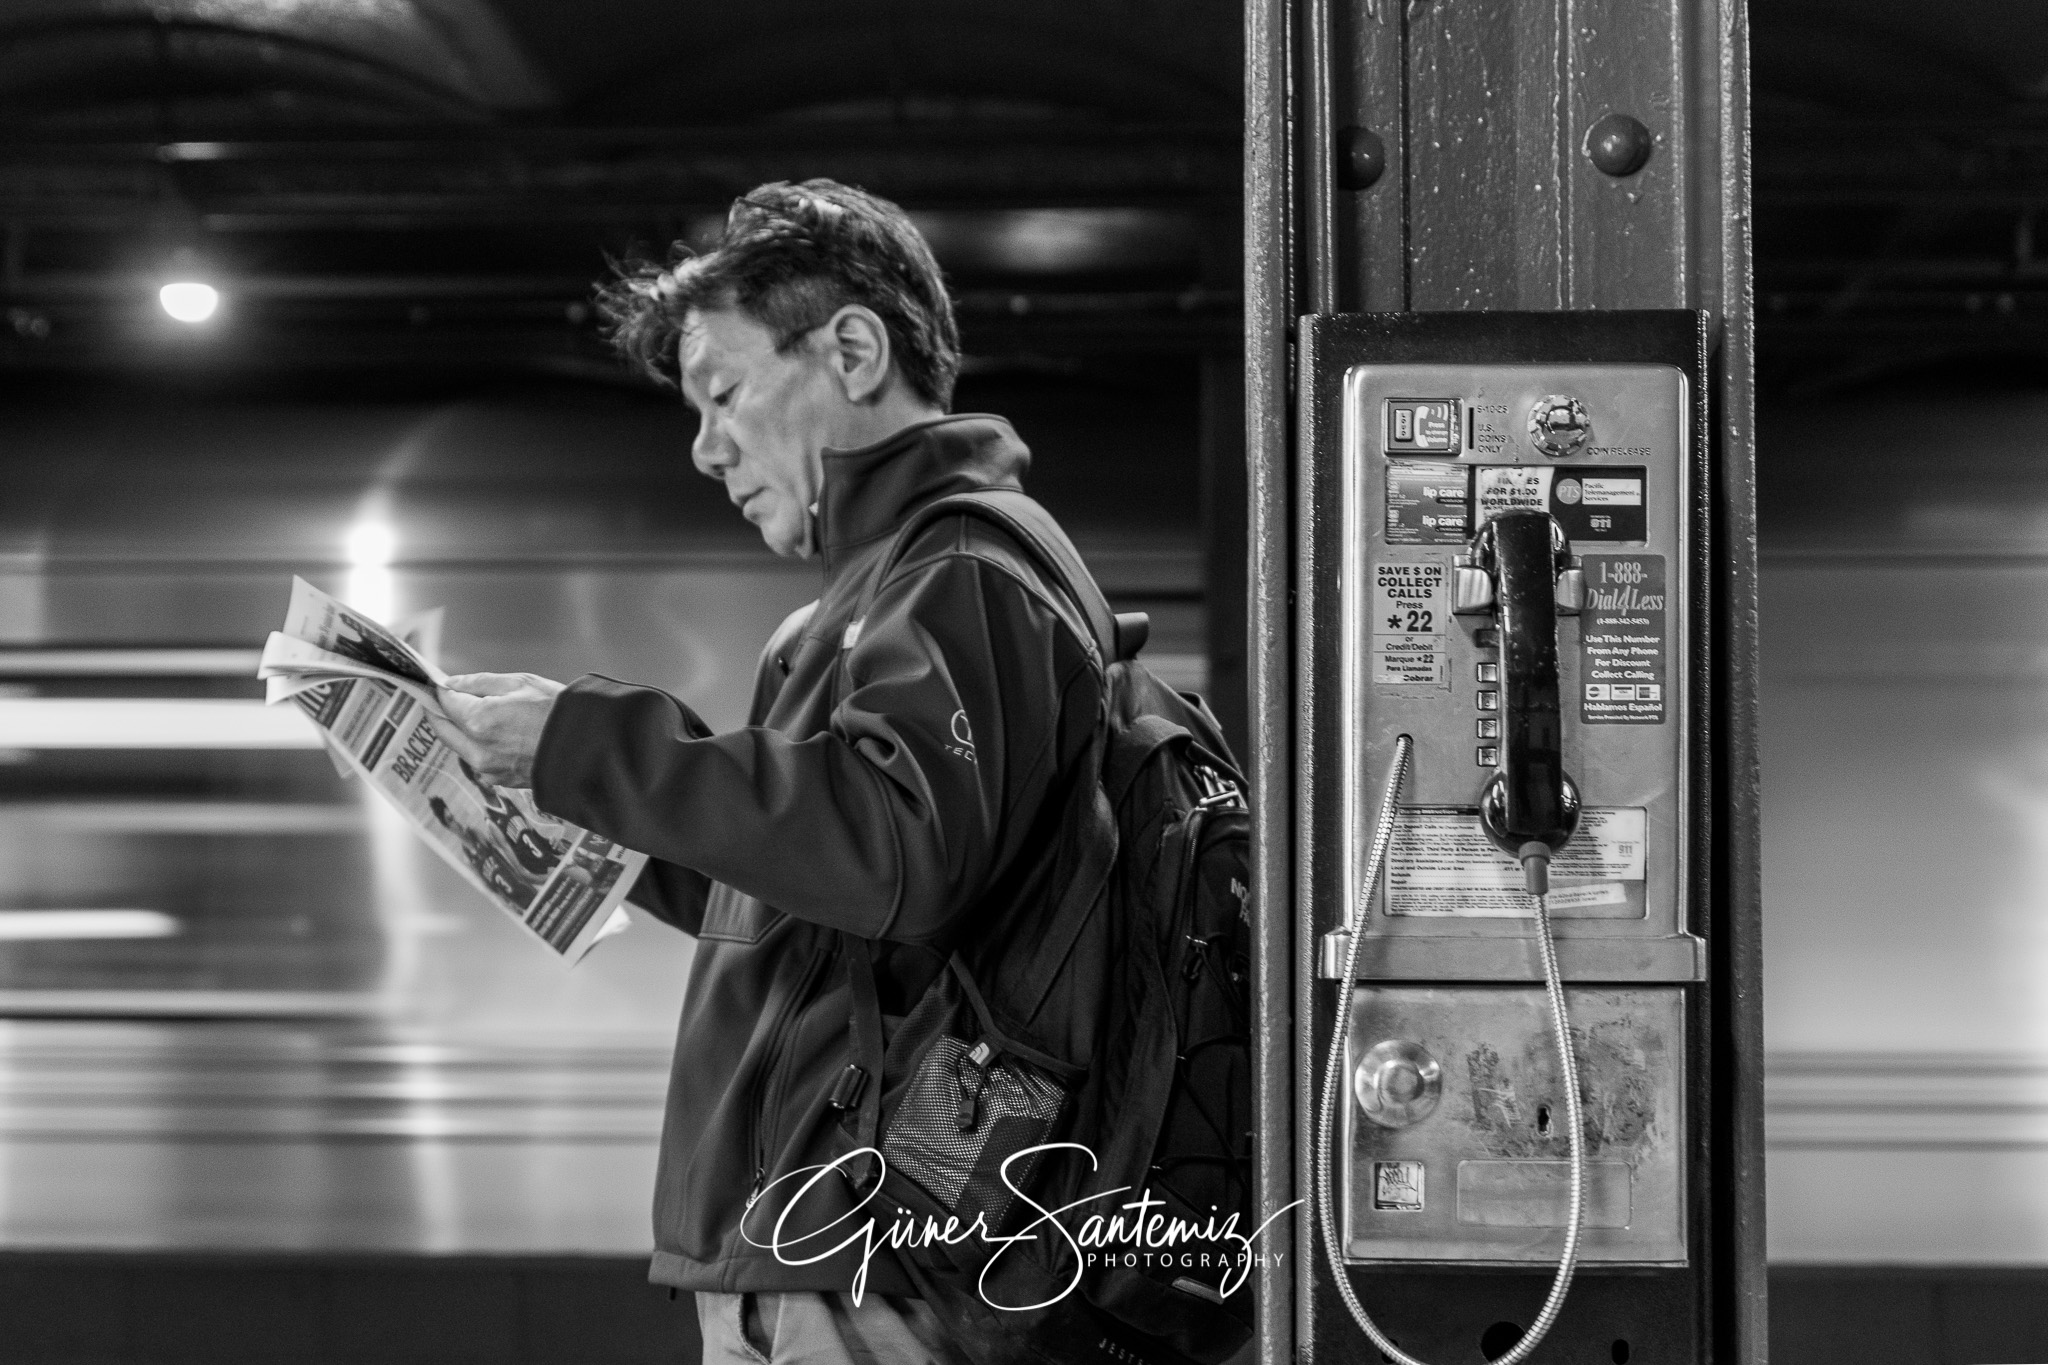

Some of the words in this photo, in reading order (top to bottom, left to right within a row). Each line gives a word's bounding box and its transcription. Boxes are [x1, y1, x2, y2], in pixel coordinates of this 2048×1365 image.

[1477, 434, 1507, 443] COINS
[1477, 445, 1503, 453] ONLY
[1586, 447, 1609, 456] COIN
[1611, 447, 1651, 456] RELEASE
[1423, 486, 1438, 498] lip
[1438, 489, 1465, 498] care
[1486, 487, 1507, 495] FOR
[1510, 488, 1537, 496] $1.00
[1559, 485, 1581, 499] PTS
[1481, 498, 1543, 506] WORLDWIDE
[1422, 515, 1437, 527] lip
[1437, 517, 1464, 527] care
[1378, 566, 1410, 575] SAVE
[1413, 566, 1421, 576] $
[1424, 566, 1442, 576] ON
[1599, 561, 1648, 584] 1-888-
[1378, 577, 1442, 587] COLLECT
[1387, 588, 1433, 599] CALLS
[1396, 600, 1424, 609] Press
[1585, 634, 1603, 643] Use
[1603, 634, 1622, 643] This
[1622, 634, 1660, 643] Number
[1586, 646, 1611, 655] From
[1611, 646, 1629, 656] Any
[1630, 646, 1659, 655] Phone
[1384, 655, 1415, 664] Marque
[1594, 658, 1611, 667] For
[1611, 658, 1651, 667] Discount
[1591, 670, 1623, 678] Collect
[1623, 670, 1655, 680] Calling
[1583, 702, 1628, 711] Hablamos
[944, 743, 976, 763] TEC
[1099, 1337, 1146, 1365] JESTE
